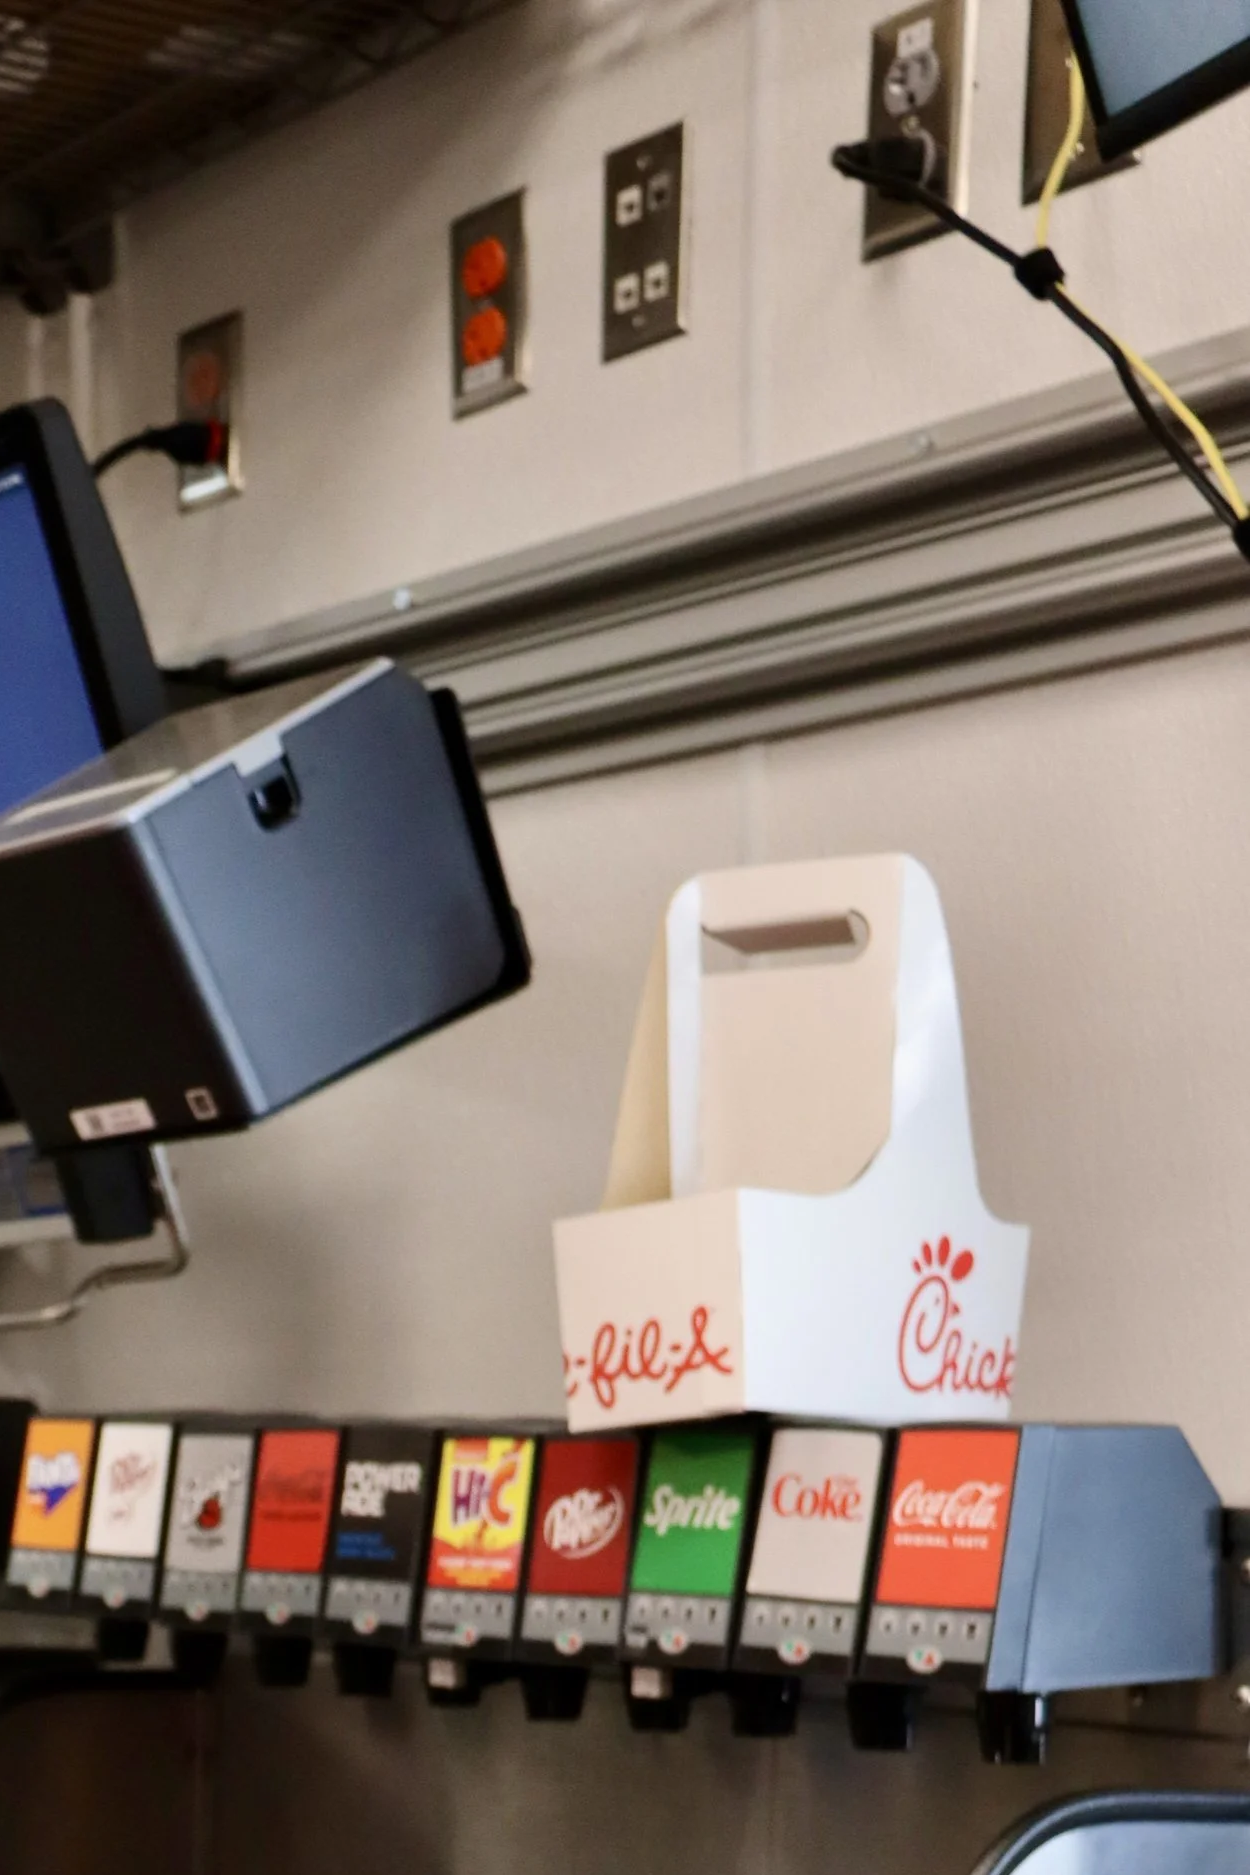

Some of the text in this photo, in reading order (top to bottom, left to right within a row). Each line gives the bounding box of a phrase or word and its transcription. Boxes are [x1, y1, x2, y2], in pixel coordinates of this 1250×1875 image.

[898, 1274, 1016, 1399] Chick
[643, 1484, 741, 1536] Sprite
[772, 1472, 862, 1521] Coke
[892, 1478, 1003, 1530] Coca-Cola
